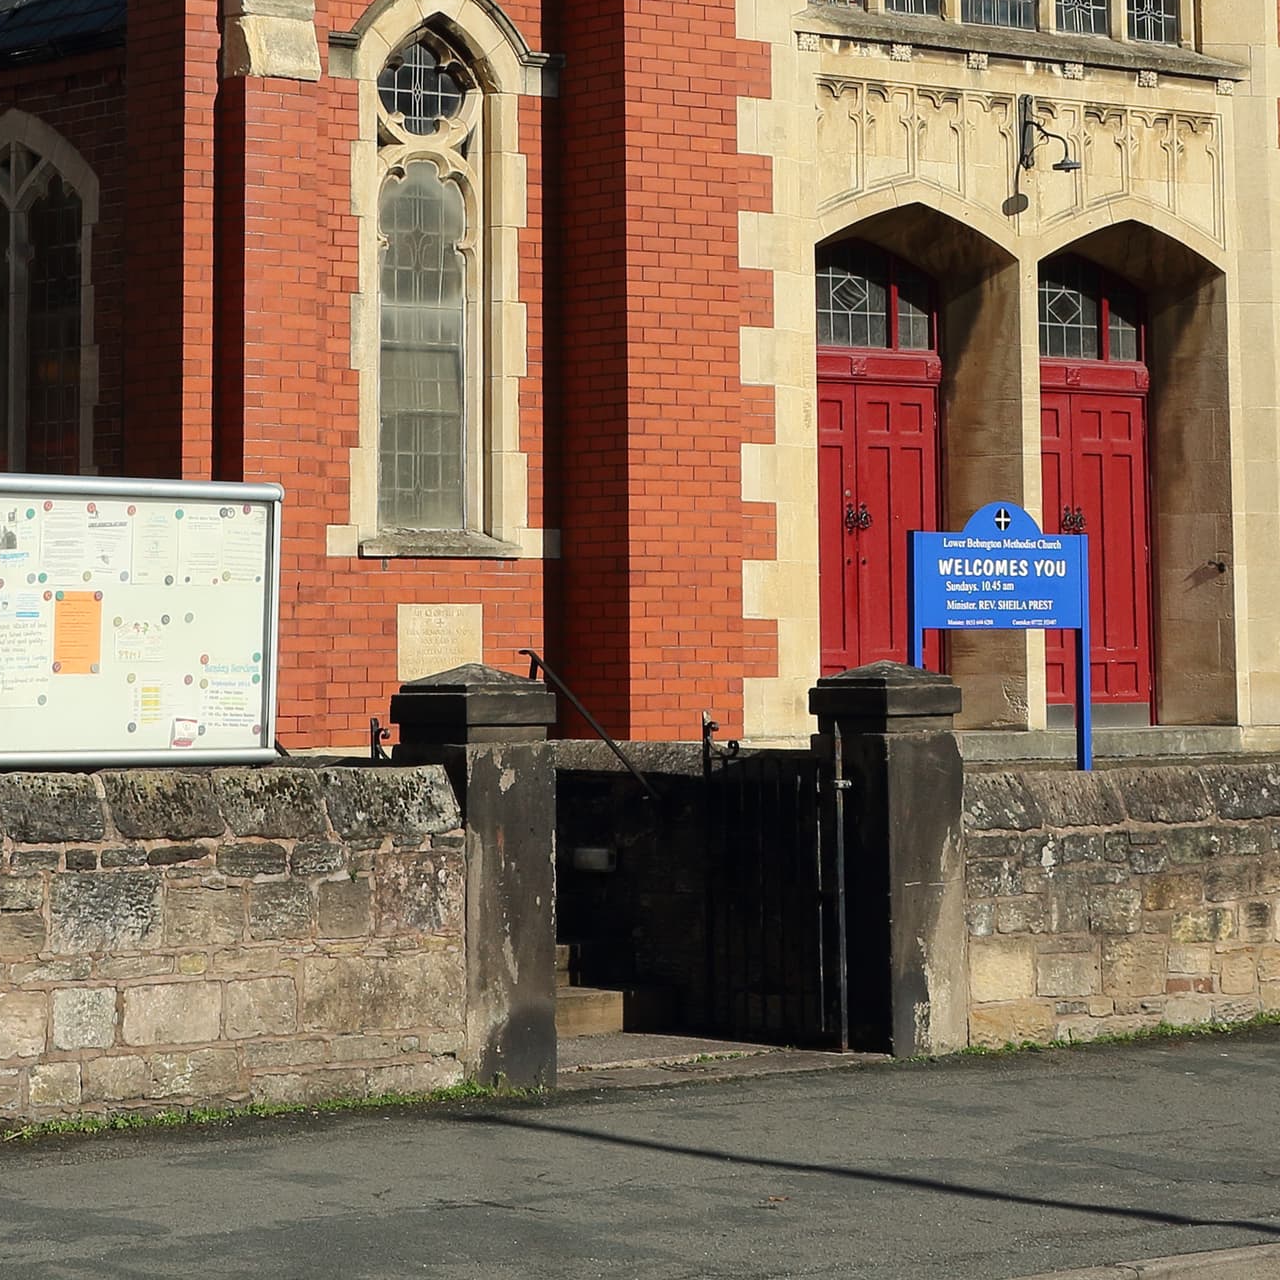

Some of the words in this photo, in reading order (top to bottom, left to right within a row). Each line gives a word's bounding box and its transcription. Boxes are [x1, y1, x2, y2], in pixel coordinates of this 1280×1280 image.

[944, 538, 966, 547] Lower
[1003, 539, 1036, 548] Methodist
[1037, 540, 1061, 549] Church
[939, 558, 1028, 576] WELCOMES
[1034, 560, 1065, 576] YOU
[982, 581, 1001, 591] 10.45
[979, 600, 996, 609] REV.
[998, 600, 1027, 609] SHEILA
[1029, 600, 1053, 610] PREST
